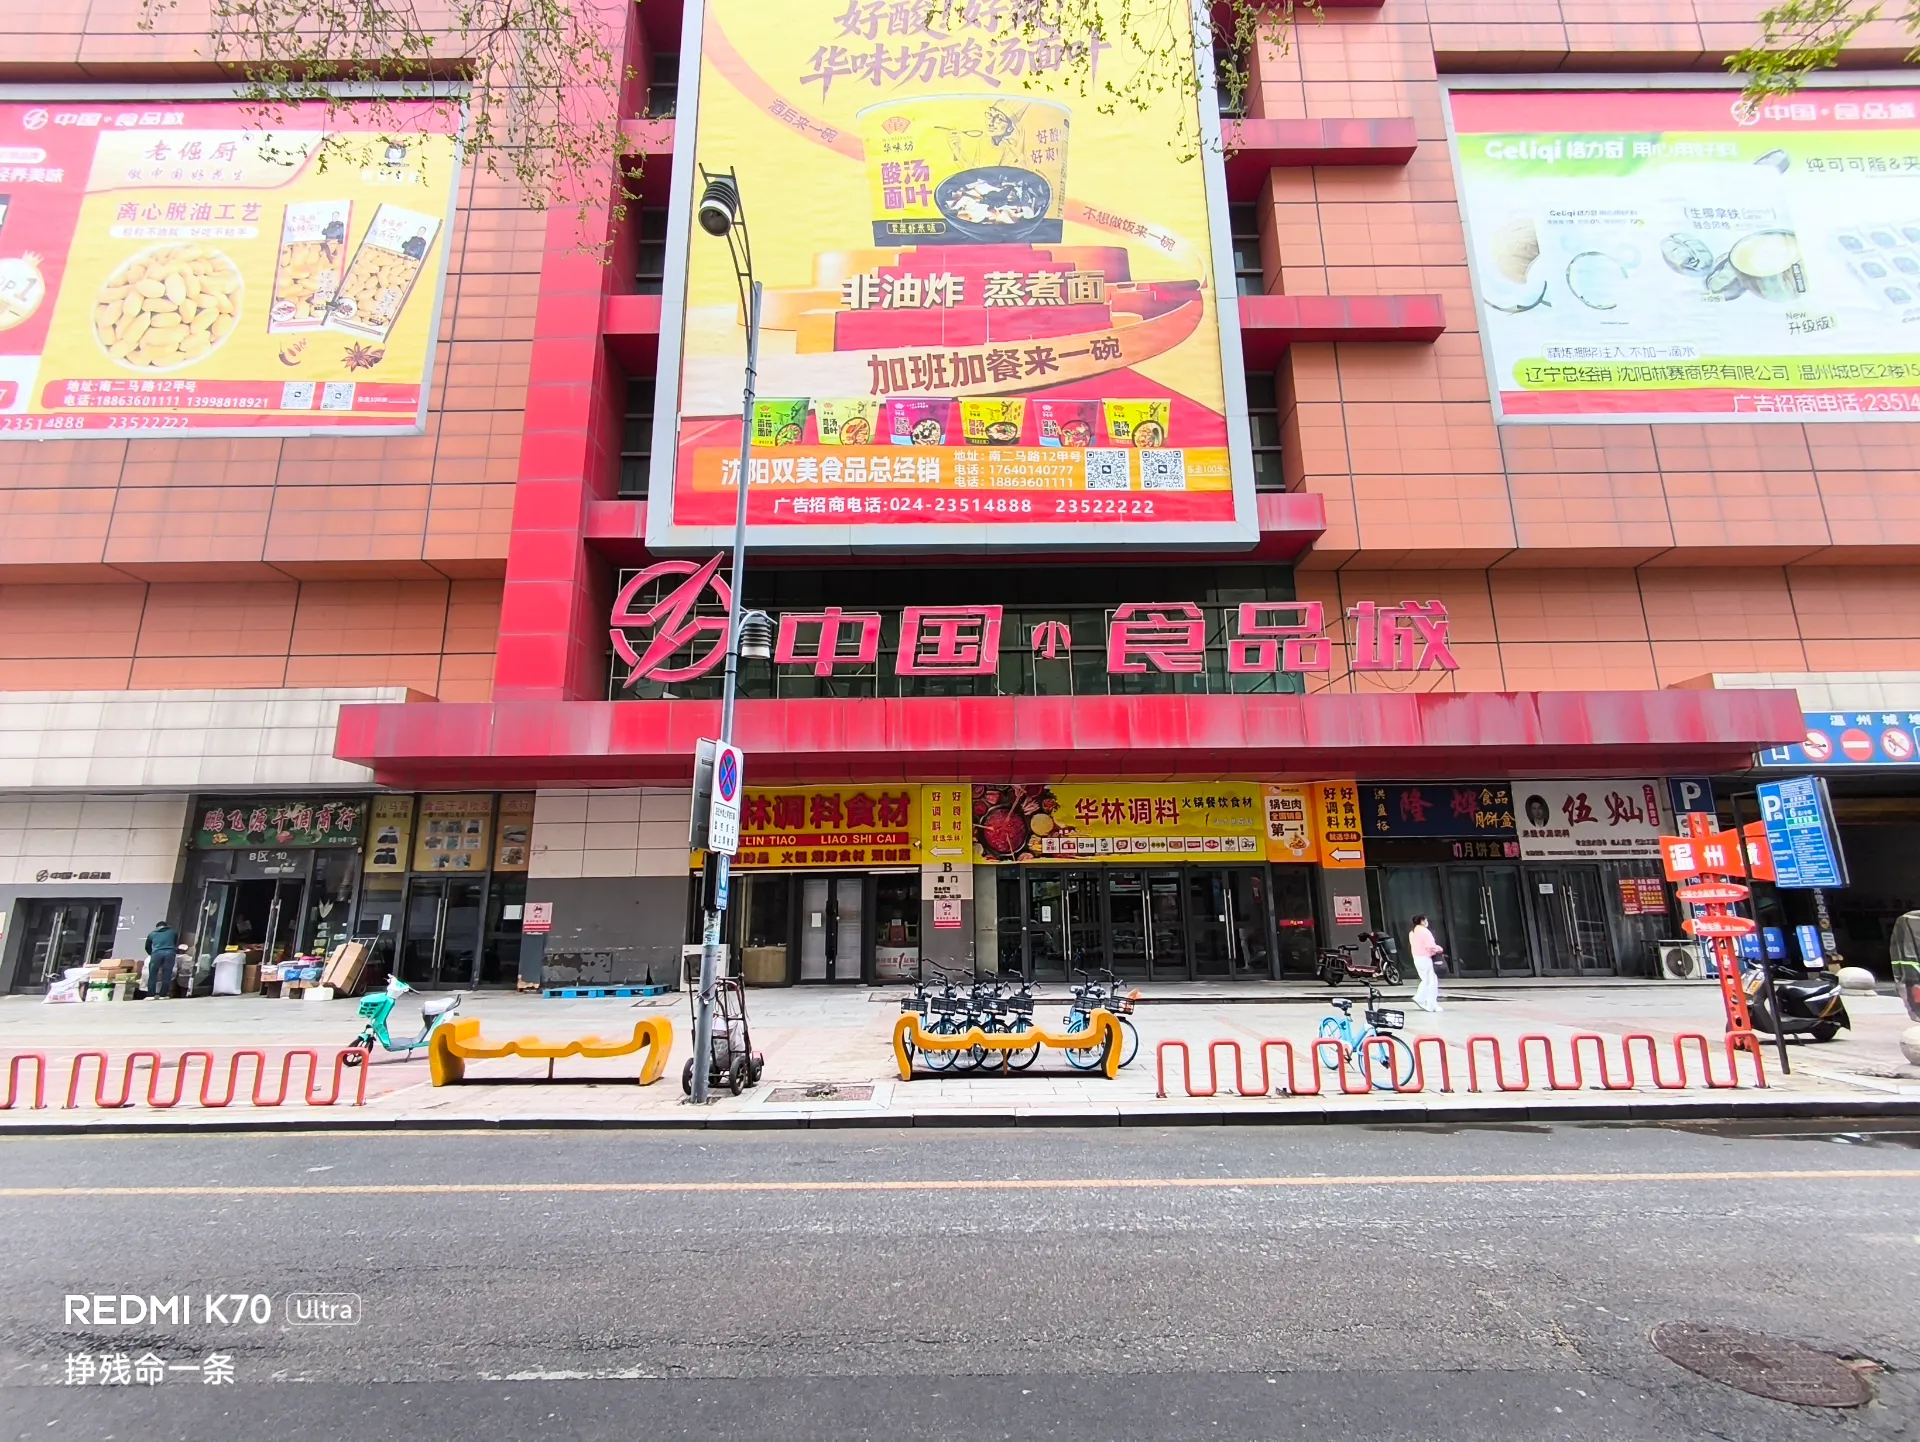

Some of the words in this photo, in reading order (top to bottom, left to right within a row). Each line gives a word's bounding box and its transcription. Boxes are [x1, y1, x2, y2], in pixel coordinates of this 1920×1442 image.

[799, 38, 1112, 104] 华味坊酸汤面叶
[768, 98, 839, 143] 酒后来一碗
[145, 140, 238, 162] 老倔厨
[881, 159, 930, 184] 酸汤
[884, 183, 933, 209] 面叶
[116, 202, 262, 222] 离心脱油工艺
[1083, 205, 1176, 251] 不想做饭来一碗
[840, 272, 964, 308] 非油炸
[983, 270, 1105, 307] 蒸煮面
[867, 336, 1123, 395] 加班加餐来一碗
[1526, 366, 1612, 383] 辽宁总经销
[1617, 364, 1789, 382] 沈阳林赛商贸有限公司
[186, 396, 269, 408] 13998818921
[108, 417, 189, 429] 23522222
[721, 456, 941, 485] 沈阳双美食品总经销
[954, 464, 1074, 476] 电话：17640140777
[954, 476, 1074, 488] 电话：18863601111
[774, 496, 1032, 513] 广告招商电话:024-23514888
[1055, 499, 1155, 514] 23522222
[1182, 796, 1253, 809] 火锅餐饮食材
[1269, 798, 1302, 810] 锅包肉
[1478, 788, 1510, 806] 食品
[1680, 782, 1702, 809] P
[1074, 797, 1180, 826] 华林调料
[1763, 795, 1781, 821] P
[202, 807, 357, 833] 鹏飞源干调商行
[1271, 823, 1305, 837] 第一!
[745, 835, 765, 846] LIN
[769, 835, 797, 845] TIAO
[820, 833, 848, 844] LIAO
[855, 833, 872, 843] SHI
[876, 833, 896, 843] CAI
[942, 862, 952, 872] B
